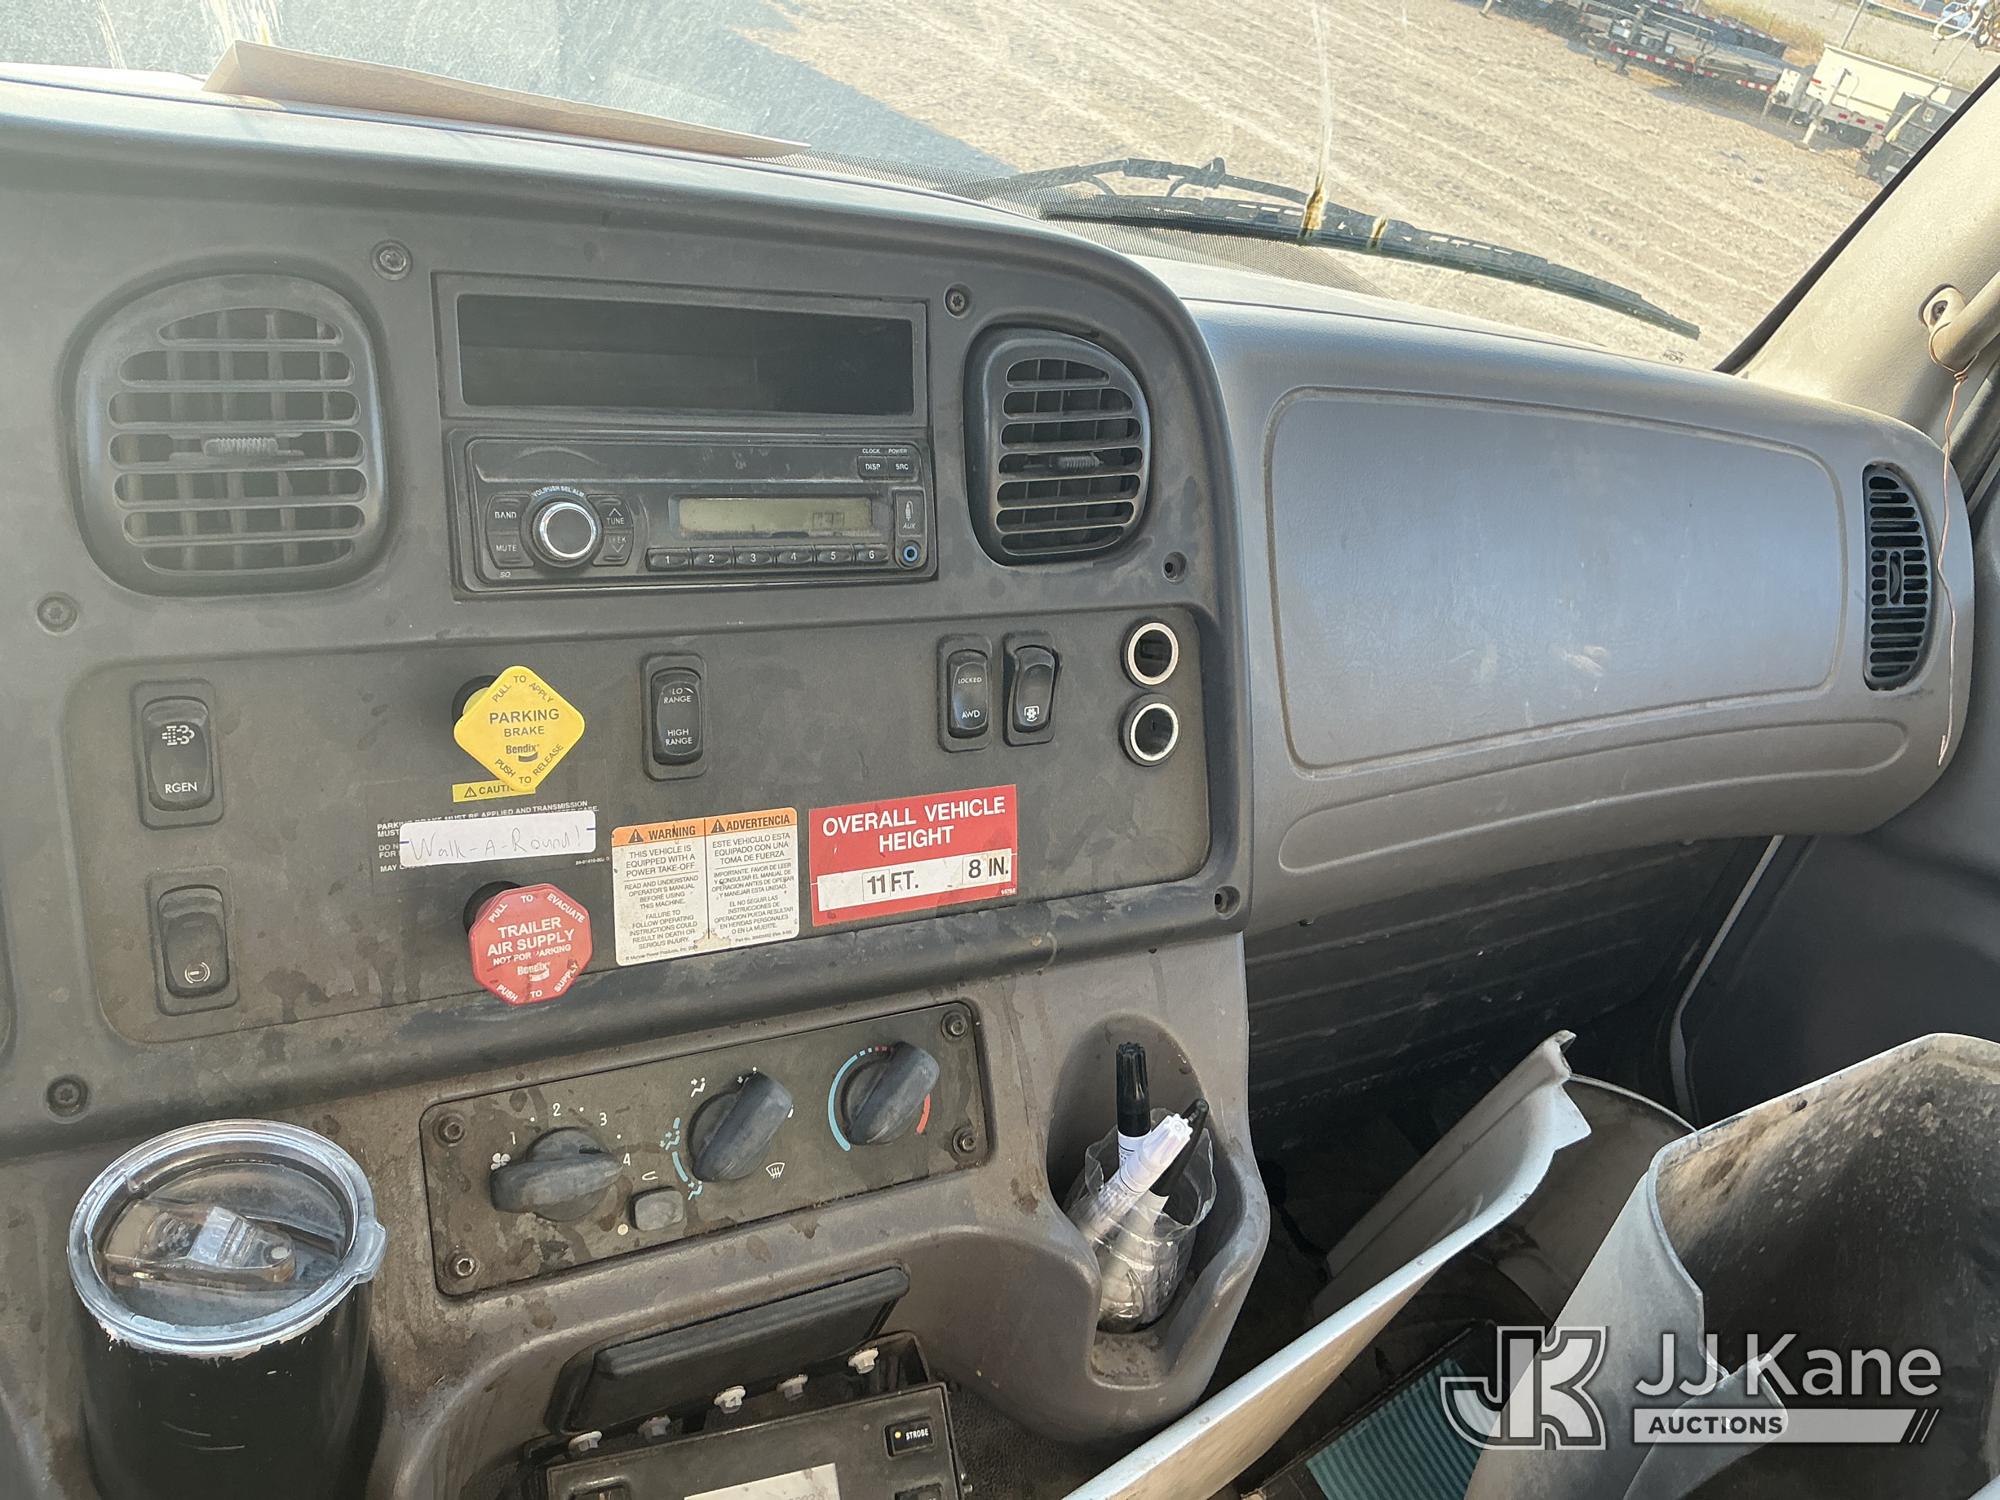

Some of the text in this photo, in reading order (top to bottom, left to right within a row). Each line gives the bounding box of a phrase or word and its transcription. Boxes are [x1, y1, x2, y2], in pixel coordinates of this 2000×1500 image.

[865, 463, 881, 471] DISP
[494, 511, 517, 519] BAND
[606, 517, 625, 525] TUNE
[665, 550, 875, 564] 1 2 3 4 5 6
[491, 675, 555, 703] PULL TO APPLY
[663, 695, 692, 704] RANGE
[489, 708, 560, 724] PARKING
[961, 709, 980, 719] AWD
[504, 725, 545, 737] BRAKE
[667, 728, 689, 736] HIGH
[665, 737, 693, 746] RANGE
[505, 744, 537, 755] Bendix
[495, 743, 564, 784] PUSH TO RELEASE
[165, 781, 198, 794] RGEN
[479, 784, 515, 795] CAUTI
[515, 806, 532, 814] AND
[532, 800, 589, 811] TRANSMISSION
[726, 814, 790, 831] ADVERTENCIA
[822, 796, 1006, 837] OVERALL VEHICLE
[377, 829, 400, 838] MUST
[648, 826, 696, 840] WARNING
[879, 825, 955, 853] HEIGHT
[712, 832, 791, 849] ESTE VEHICULO ESTA
[379, 850, 397, 858] FOR
[629, 844, 692, 859] THIS VEHICLE IS
[714, 841, 789, 857] EQUIPADO CON UNA
[625, 857, 666, 869] EQUIPPED
[668, 854, 688, 863] WITH
[720, 850, 785, 865] TOMA DE FUERZA
[380, 864, 398, 872] MAY
[626, 861, 695, 877] POWER TAKE-OFF
[867, 856, 1009, 895] 11 FT. 8 IN.
[624, 883, 641, 891] READ
[657, 875, 699, 886] UNDERSTAND
[669, 883, 695, 892] MANUAL
[639, 891, 686, 903] BEFORE USING
[488, 892, 586, 923] PULL TO EVACUATE
[640, 902, 654, 910] THIS
[632, 914, 694, 929] FOLLOW OPERATING
[646, 910, 671, 920] FAILURE
[497, 916, 562, 939] TRAILER
[629, 921, 698, 937] INSTRUCTIONS COULD
[487, 928, 575, 957] AIR SUPPLY
[632, 934, 656, 944] RESULT
[664, 930, 685, 938] DEATH
[638, 939, 666, 950] SERIOUS
[492, 954, 512, 966] NOT
[513, 951, 532, 962] FOR
[496, 962, 578, 1001] PUSH TO SUPPLY
[552, 1102, 562, 1117] 2
[599, 1112, 608, 1126] 3
[510, 1131, 516, 1145] 1
[622, 1152, 631, 1166] 4
[905, 1428, 929, 1441] STROBE
